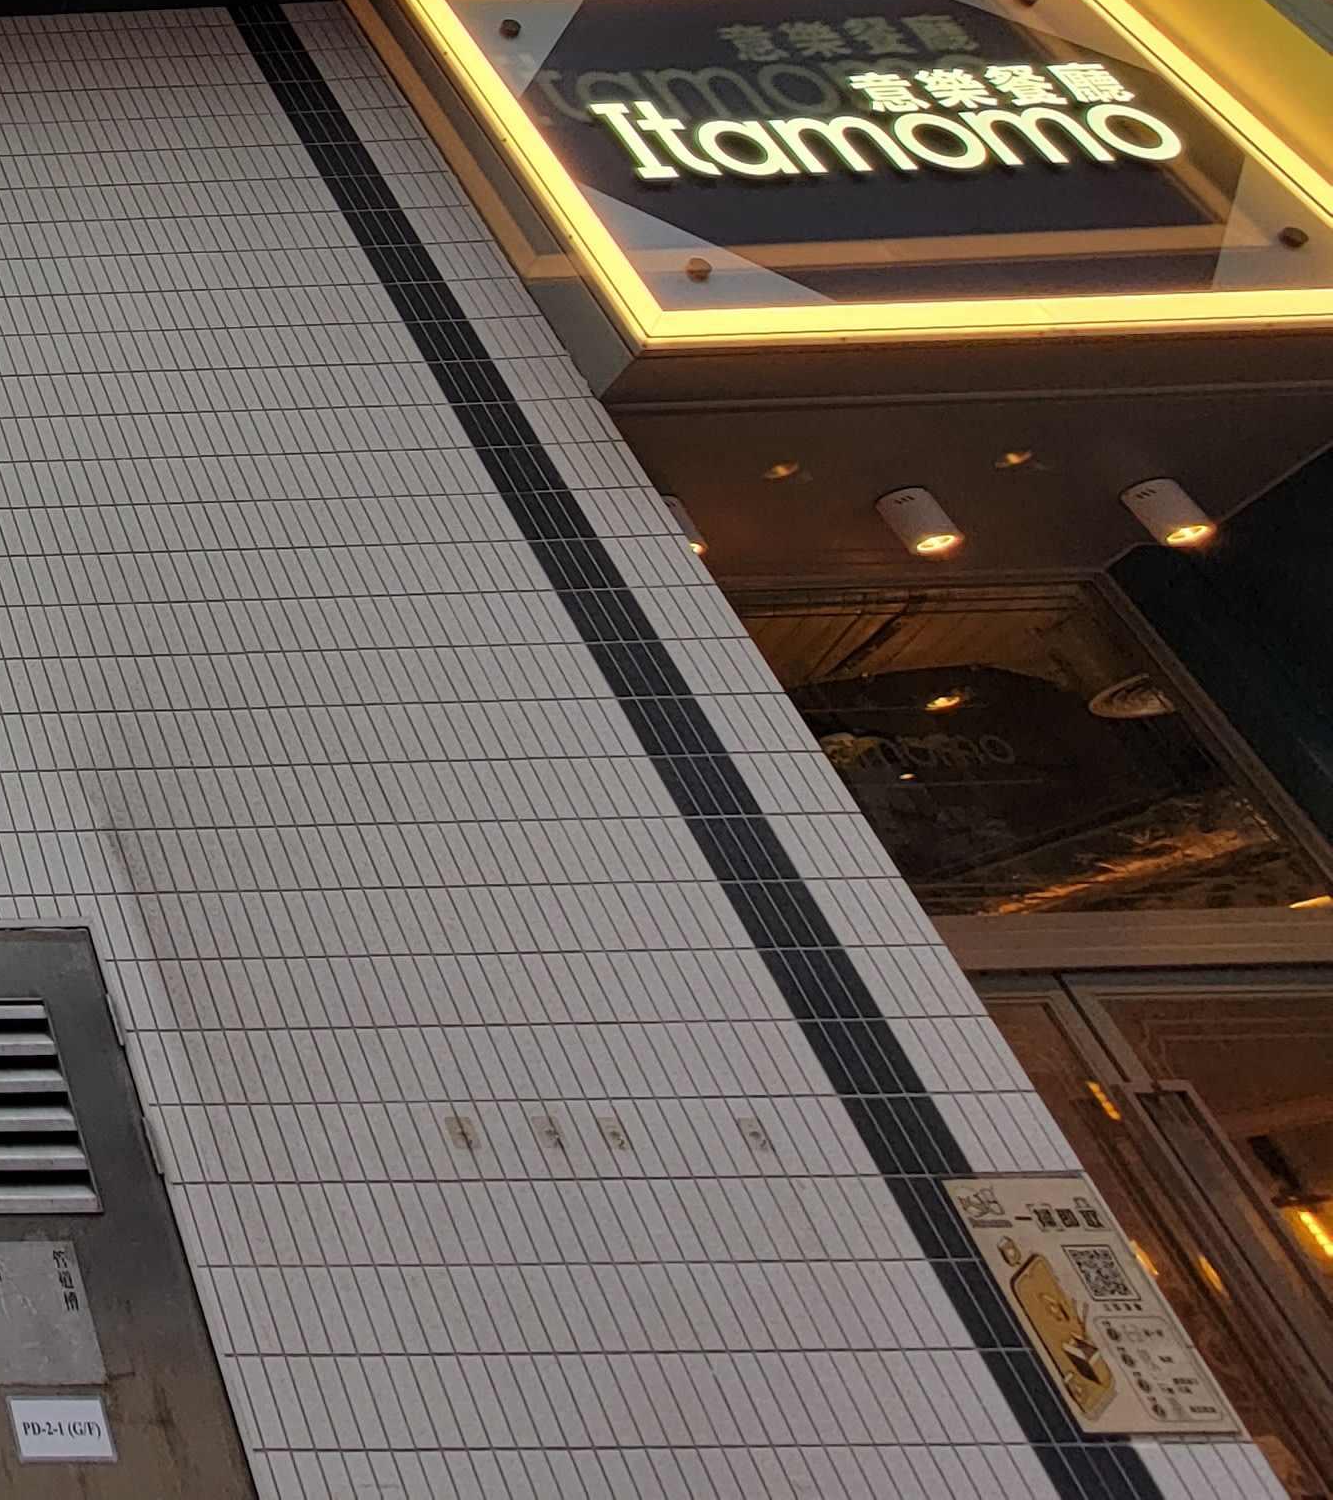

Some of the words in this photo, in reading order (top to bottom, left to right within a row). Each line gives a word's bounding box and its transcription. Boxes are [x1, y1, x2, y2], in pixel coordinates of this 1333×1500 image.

[849, 61, 1136, 112] 意樂餐廳
[589, 98, 1183, 182] Itamomo
[22, 1422, 65, 1437] PD-2-1
[68, 1422, 101, 1439] (G/F)
